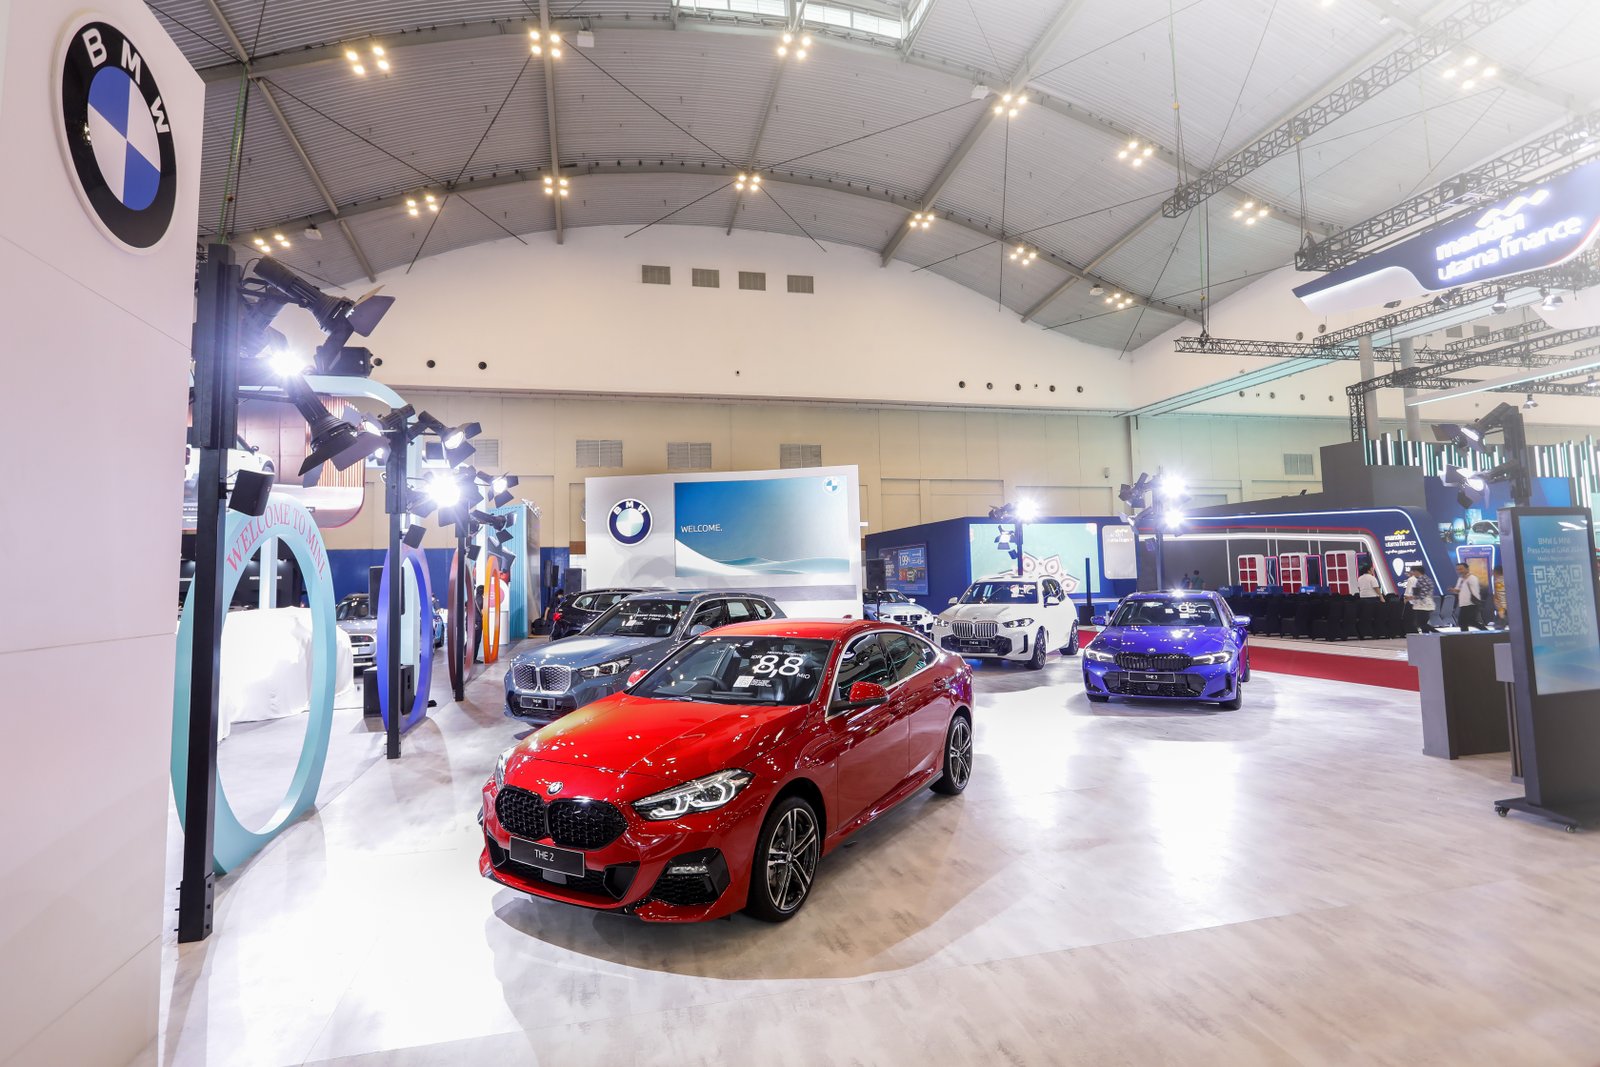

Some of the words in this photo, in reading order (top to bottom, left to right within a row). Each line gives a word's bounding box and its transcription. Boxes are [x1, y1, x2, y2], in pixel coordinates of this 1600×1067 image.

[82, 28, 170, 133] BMW
[1436, 213, 1525, 261] mandiri
[1438, 247, 1500, 281] utama
[1500, 217, 1582, 259] finance
[613, 500, 647, 516] BMW
[227, 503, 290, 572] WELCOME
[293, 508, 305, 535] TO
[680, 523, 723, 533] WELCOME.
[754, 655, 804, 678] 8,8
[534, 849, 548, 861] THE
[549, 852, 555, 862] 2
